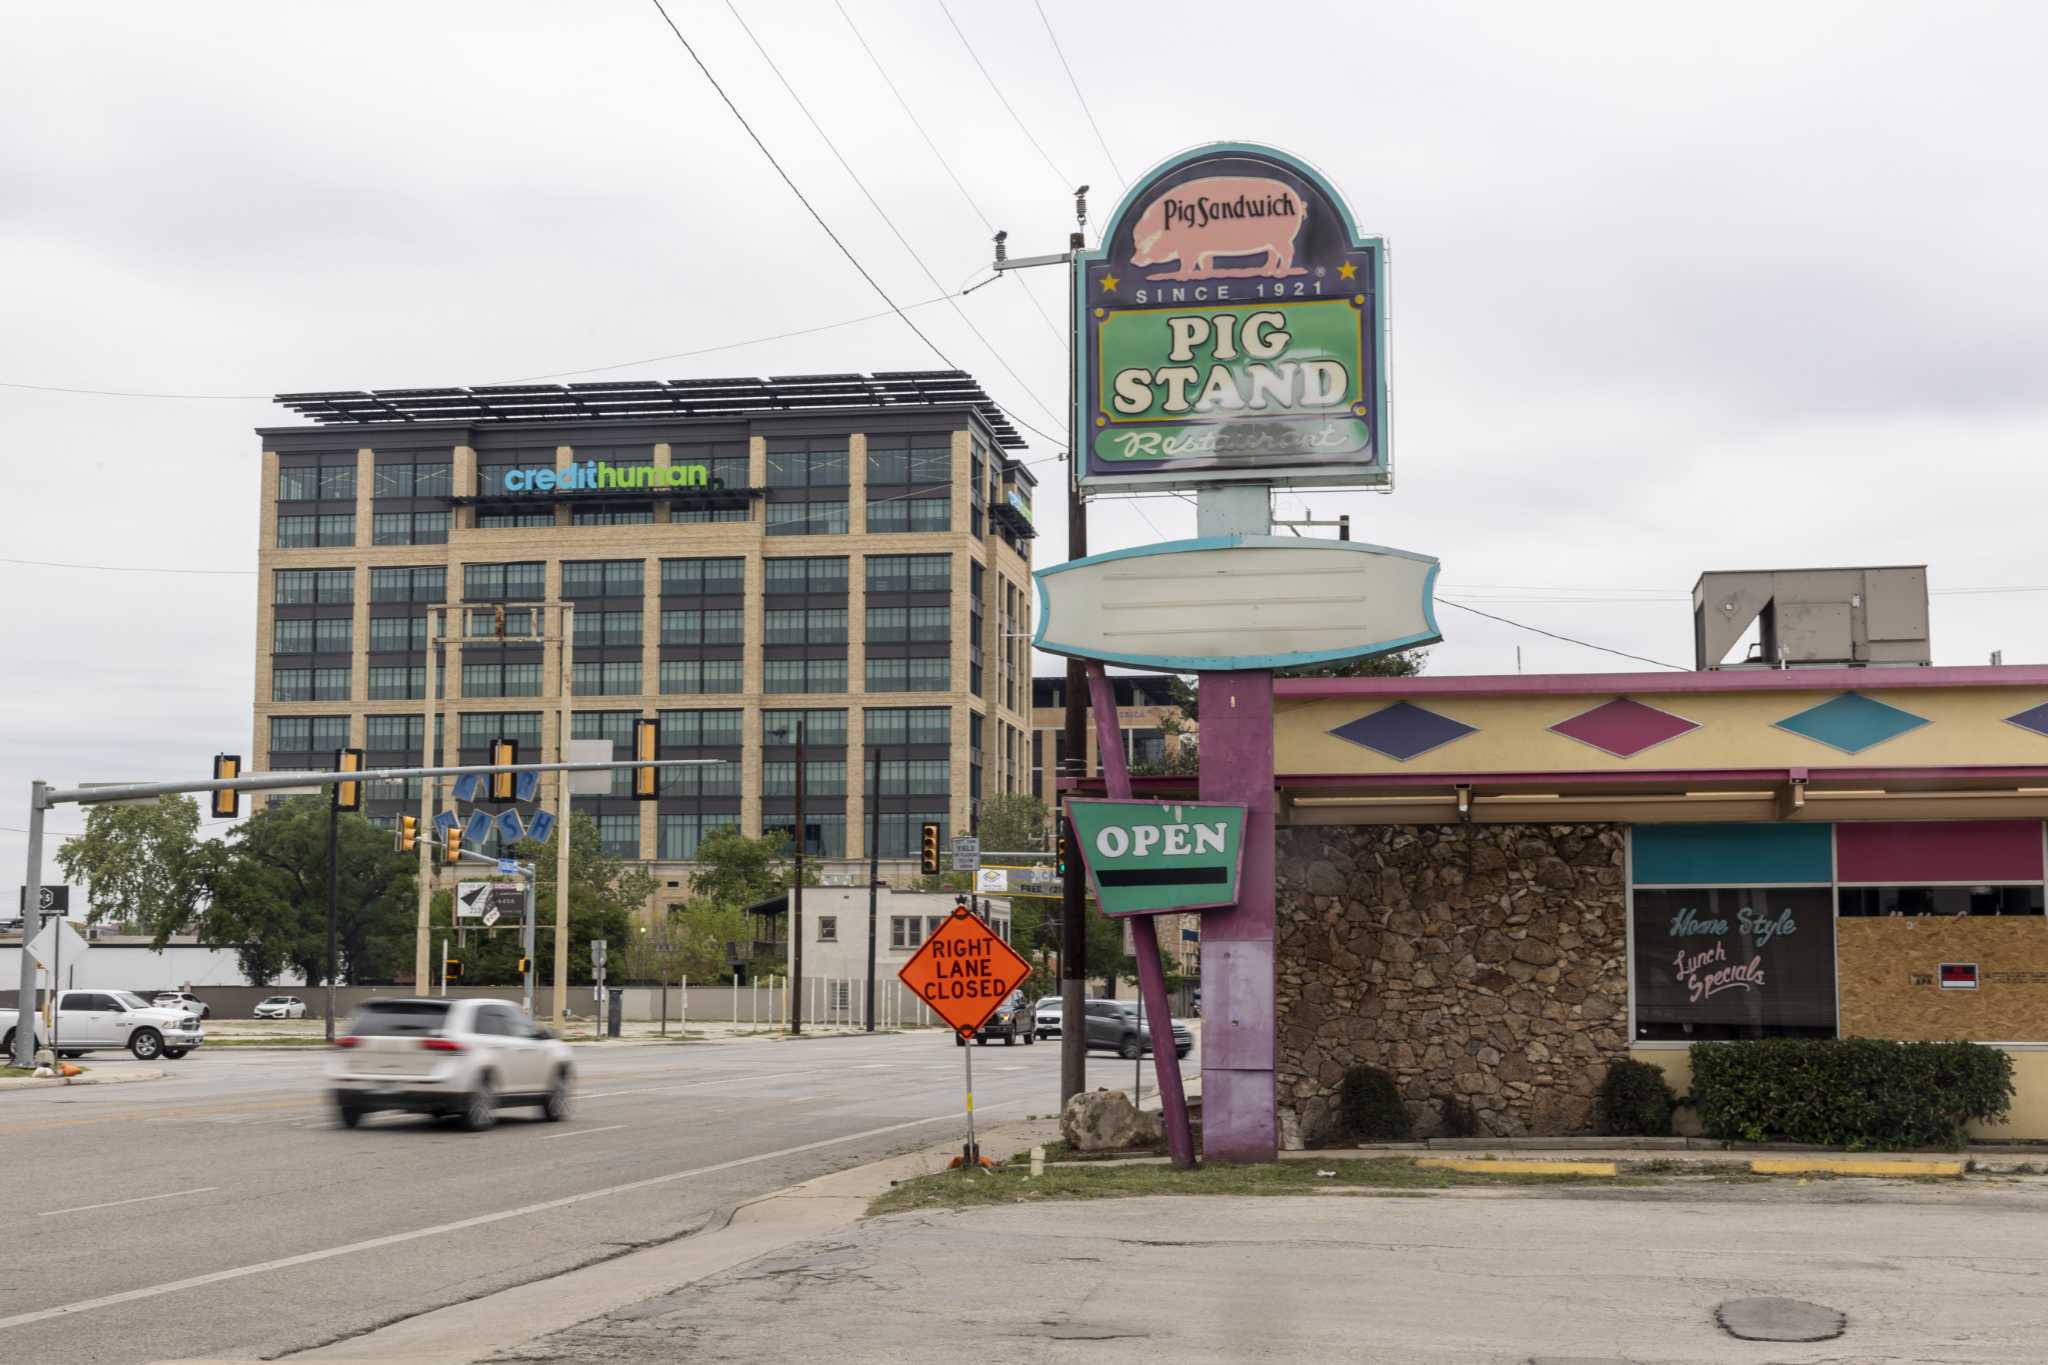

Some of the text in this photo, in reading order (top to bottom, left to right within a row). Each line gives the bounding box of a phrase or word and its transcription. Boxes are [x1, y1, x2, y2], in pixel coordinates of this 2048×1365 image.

[1135, 281, 1322, 303] SINCE 1921
[1167, 312, 1292, 361] PIG
[1113, 360, 1348, 414] STAND
[1096, 822, 1228, 858] OPEN
[1669, 907, 1797, 947] Home Style
[932, 938, 993, 958] RIGHT
[1673, 941, 1726, 981] Lunch
[936, 959, 992, 979] LANE
[1687, 955, 1766, 1003] Specials
[924, 978, 1006, 1000] CLOSED
